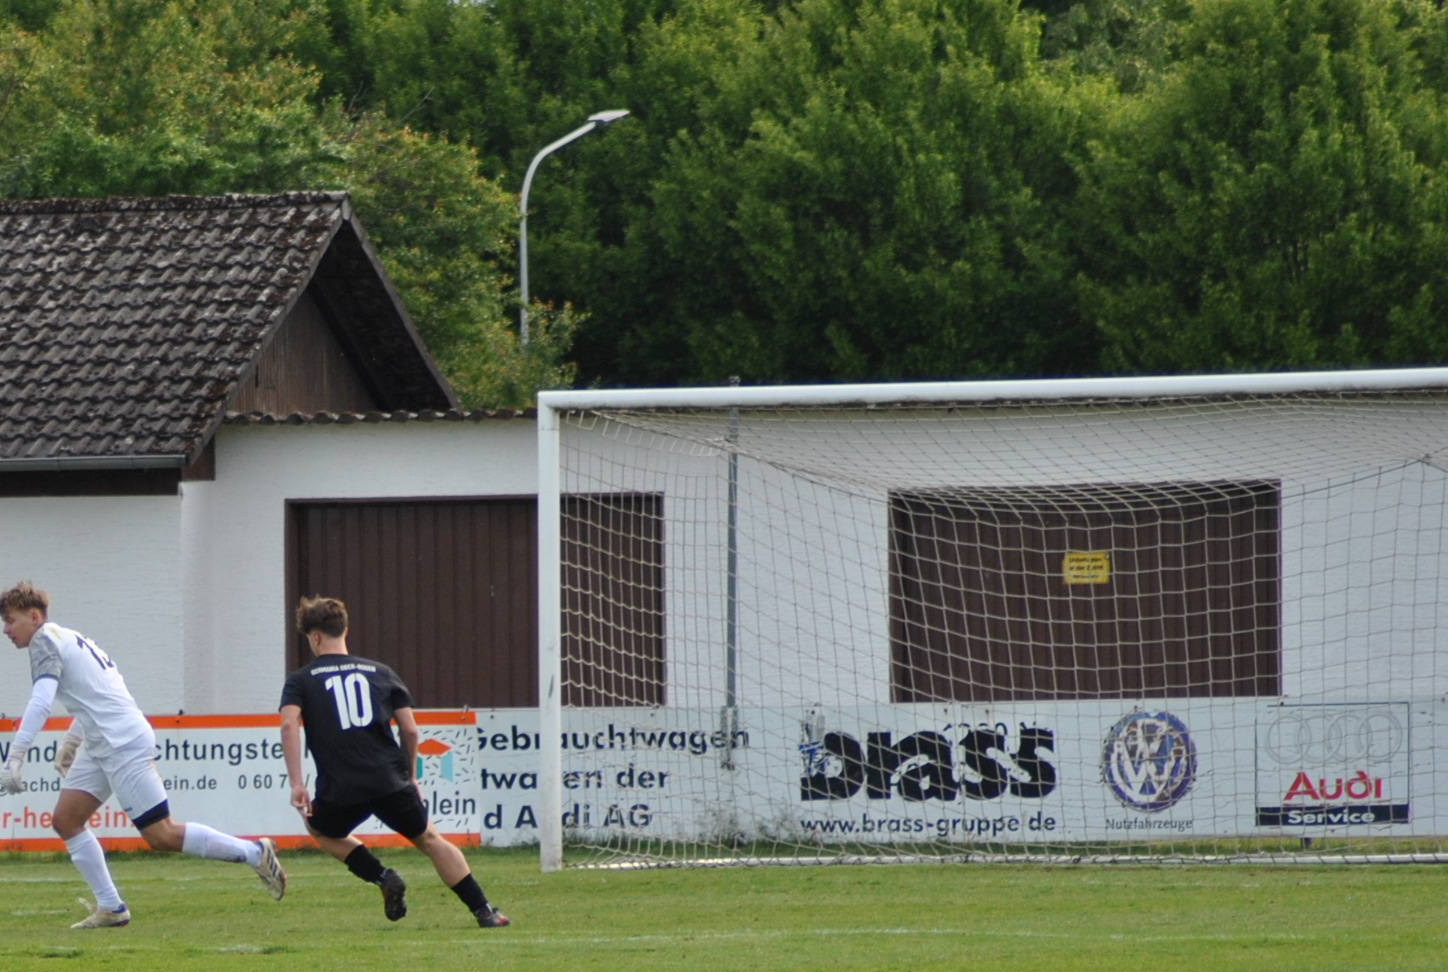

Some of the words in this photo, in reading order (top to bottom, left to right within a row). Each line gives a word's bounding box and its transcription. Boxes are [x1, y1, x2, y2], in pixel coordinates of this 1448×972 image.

[325, 672, 373, 730] 10
[481, 768, 602, 789] twaen
[616, 763, 669, 788] der
[799, 728, 1056, 801] brass
[1283, 770, 1382, 801] Audi
[514, 803, 590, 830] Adi
[603, 803, 653, 829] AG
[1106, 817, 1192, 832] Nutzfahrzeuge
[1287, 809, 1375, 824] Service
